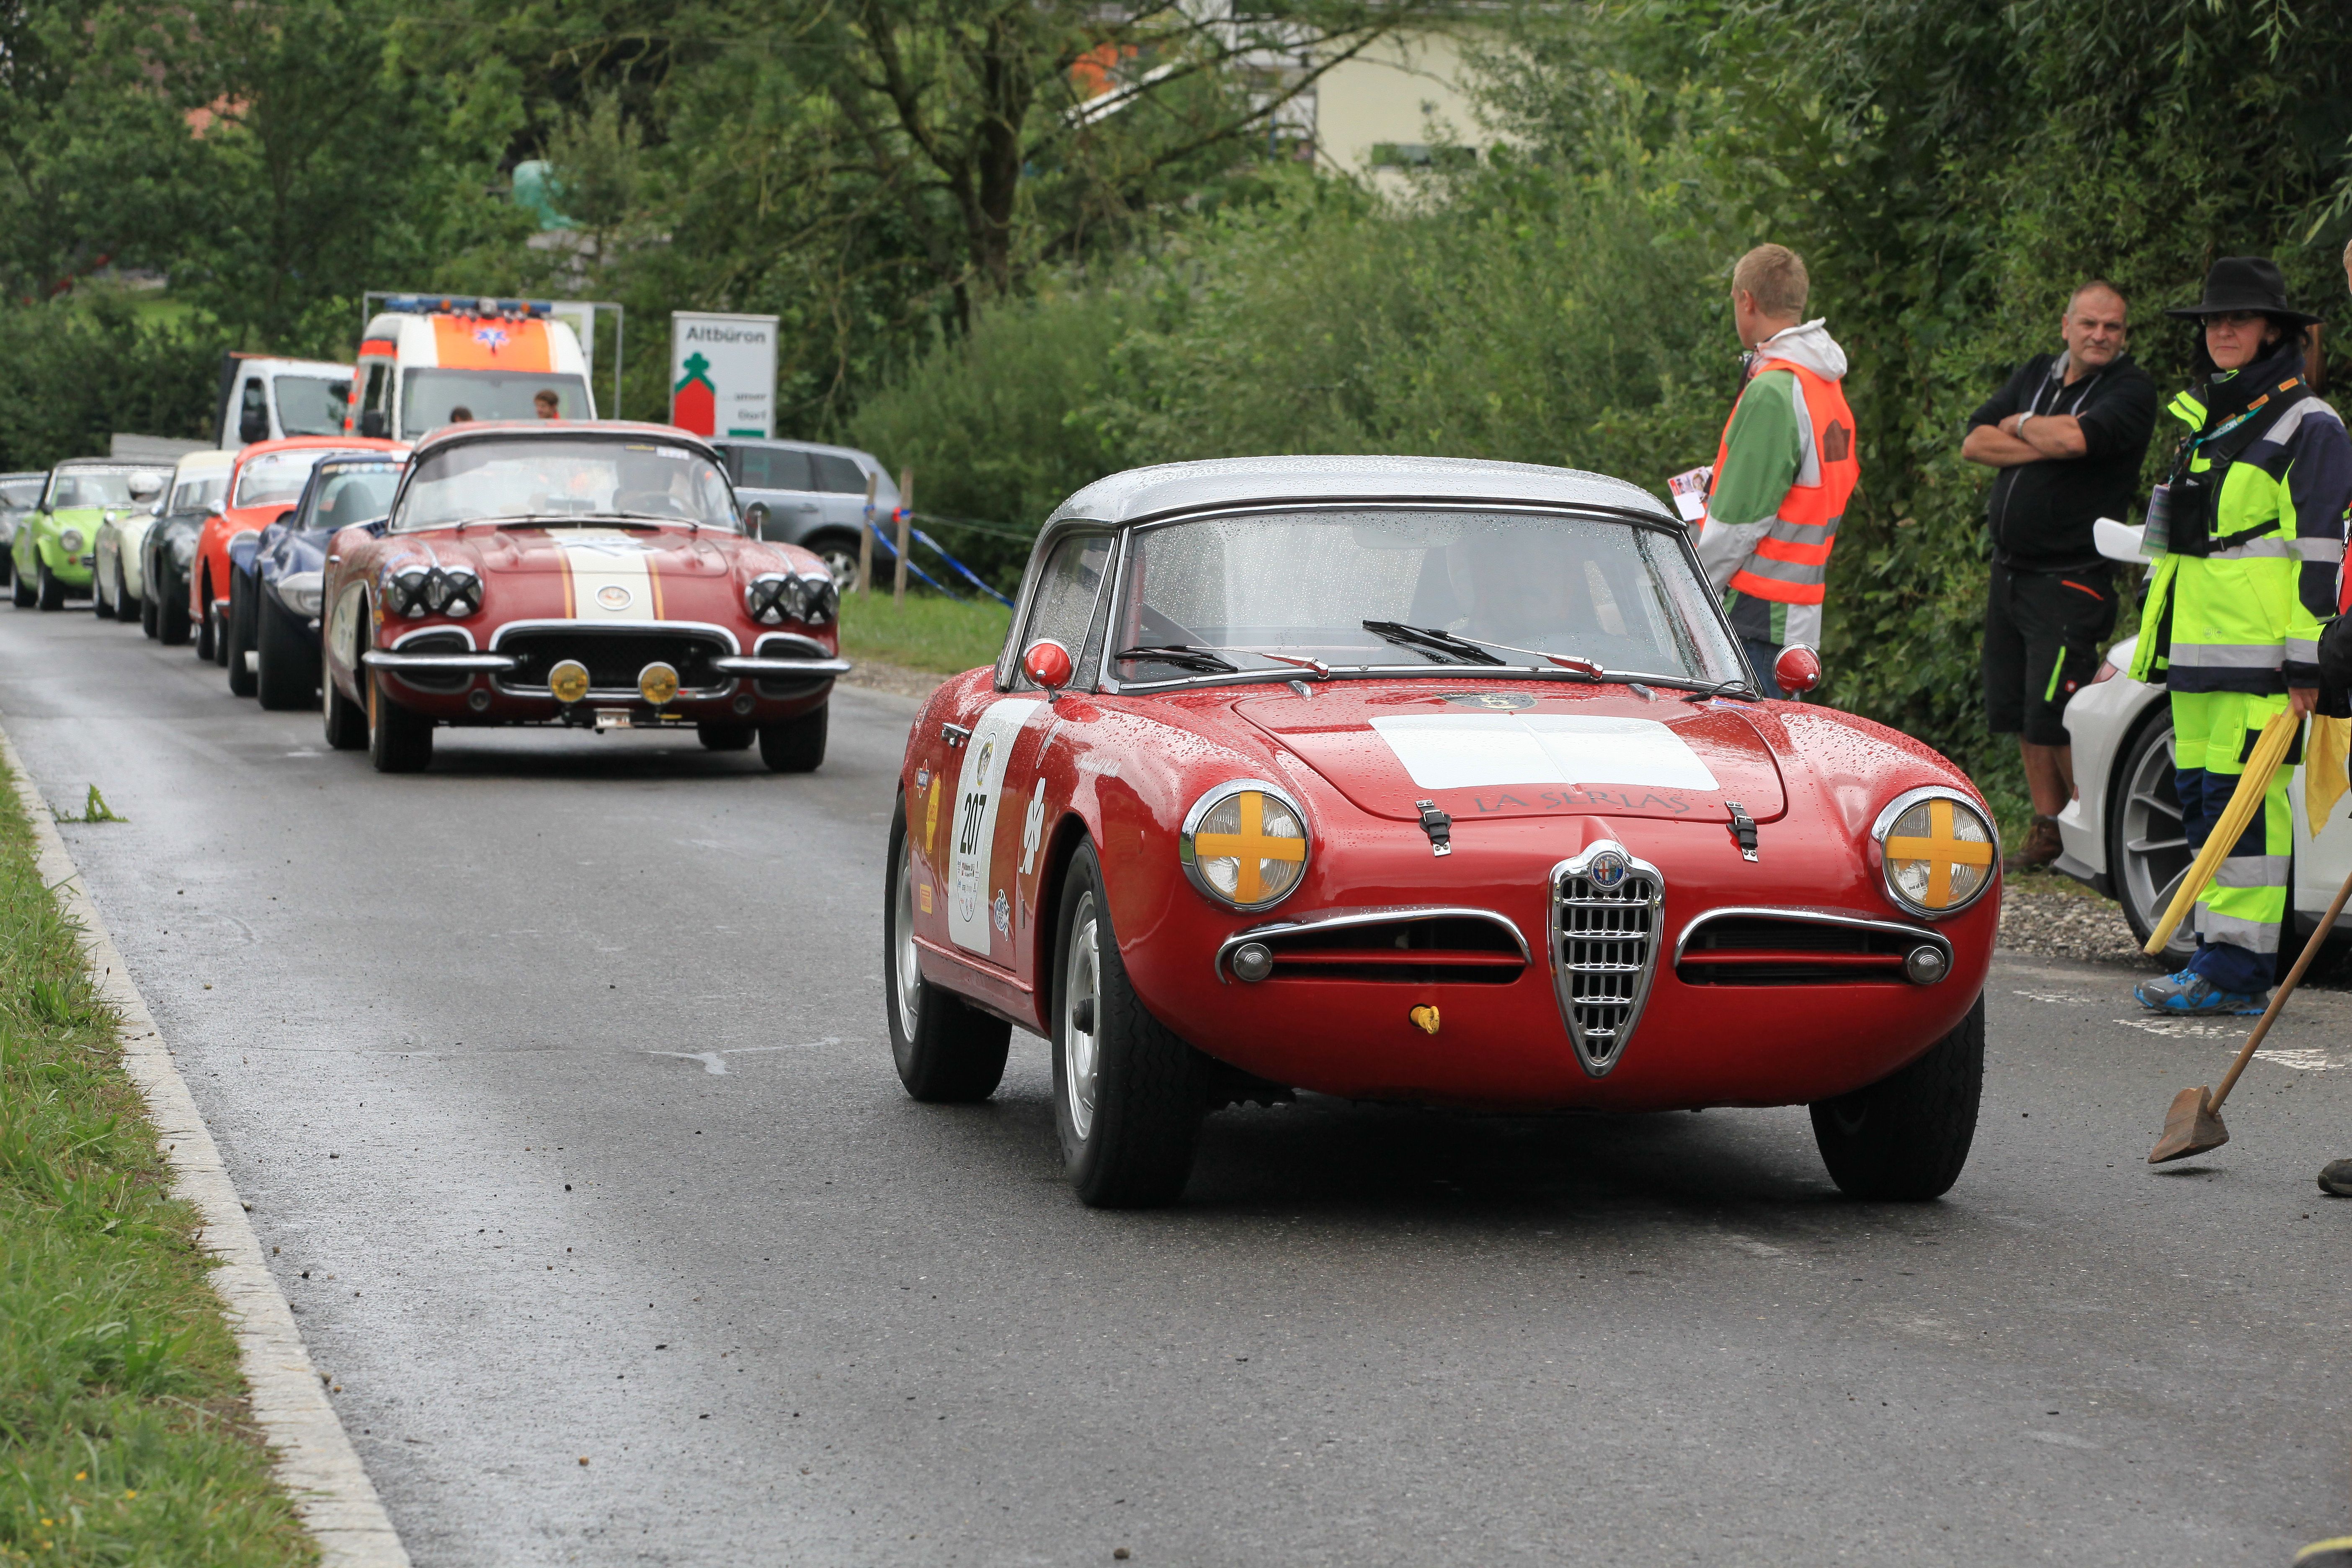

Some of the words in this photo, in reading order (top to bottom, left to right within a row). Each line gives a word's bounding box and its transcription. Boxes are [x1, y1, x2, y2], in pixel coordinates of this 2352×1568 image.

[686, 325, 766, 345] Altbüron
[1475, 794, 1530, 812] LA
[1541, 791, 1690, 814] SERLAS
[960, 792, 987, 855] 207
